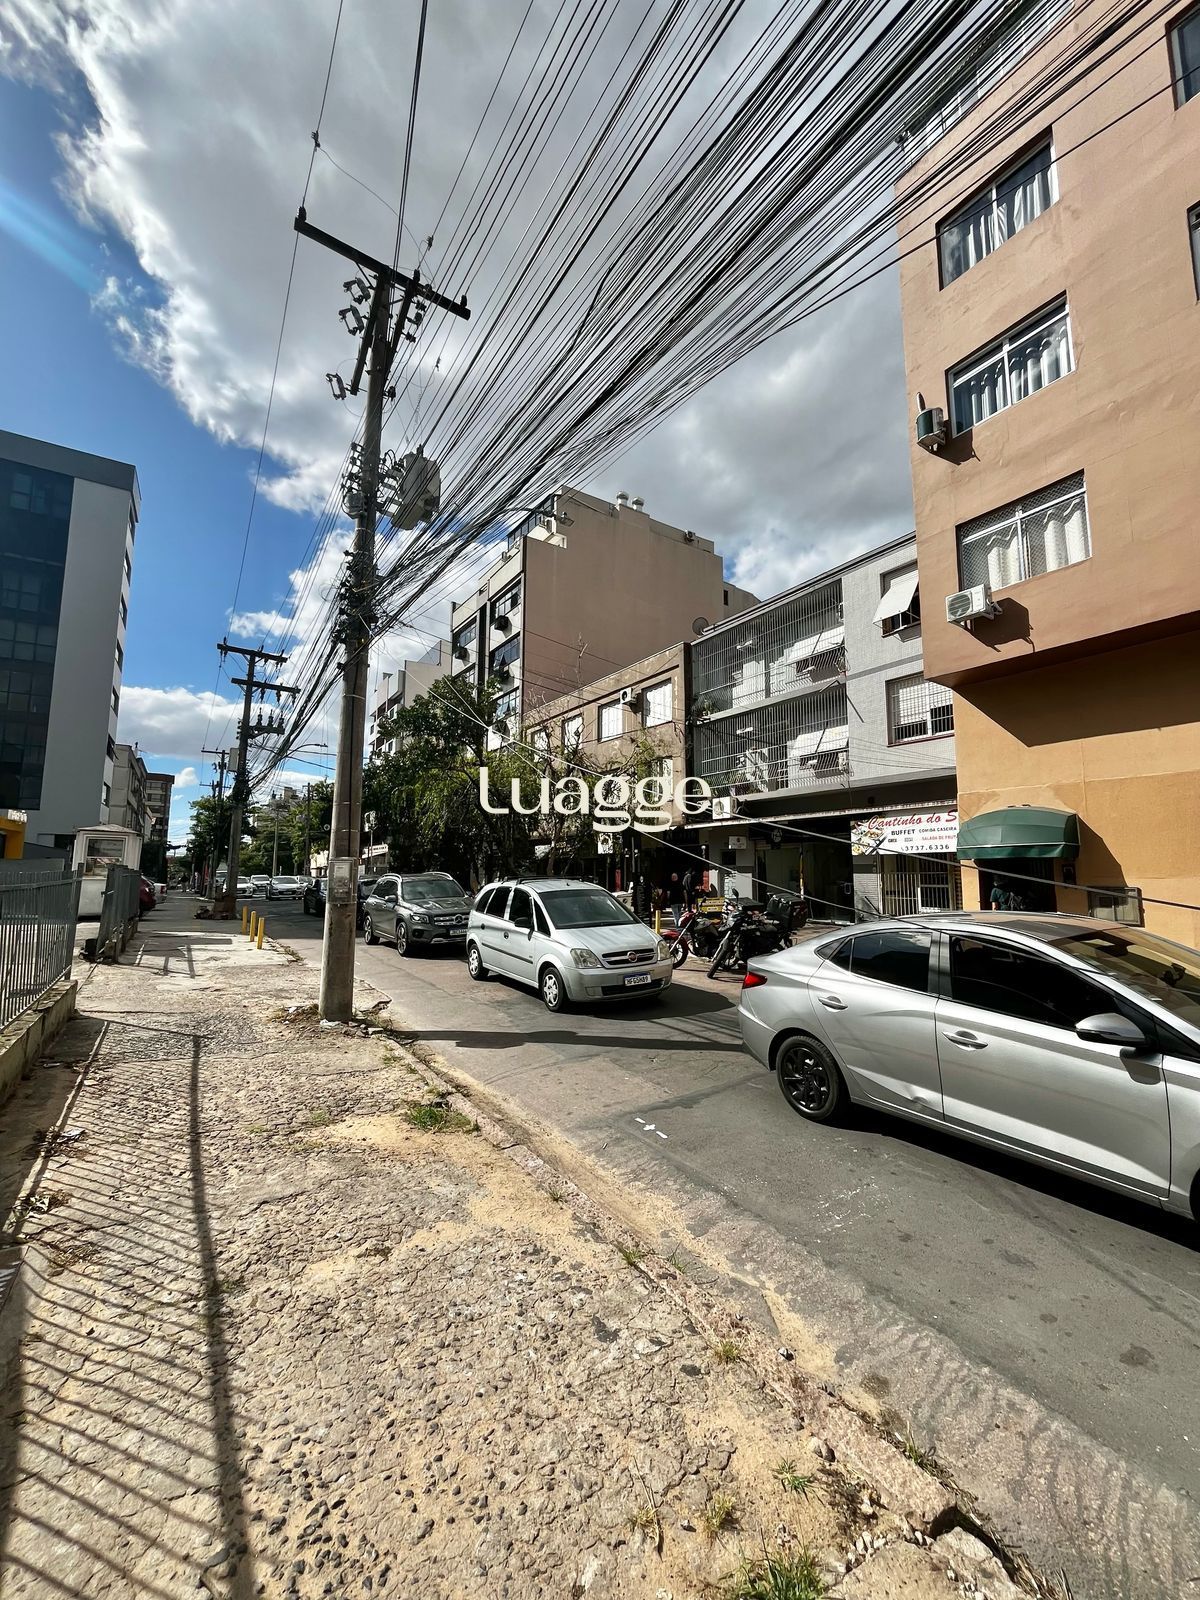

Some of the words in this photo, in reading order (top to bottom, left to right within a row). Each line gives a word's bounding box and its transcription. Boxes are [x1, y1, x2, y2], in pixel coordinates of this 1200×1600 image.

[867, 813, 922, 830] Cantinho
[926, 813, 941, 824] do
[891, 828, 916, 836] BUFFET
